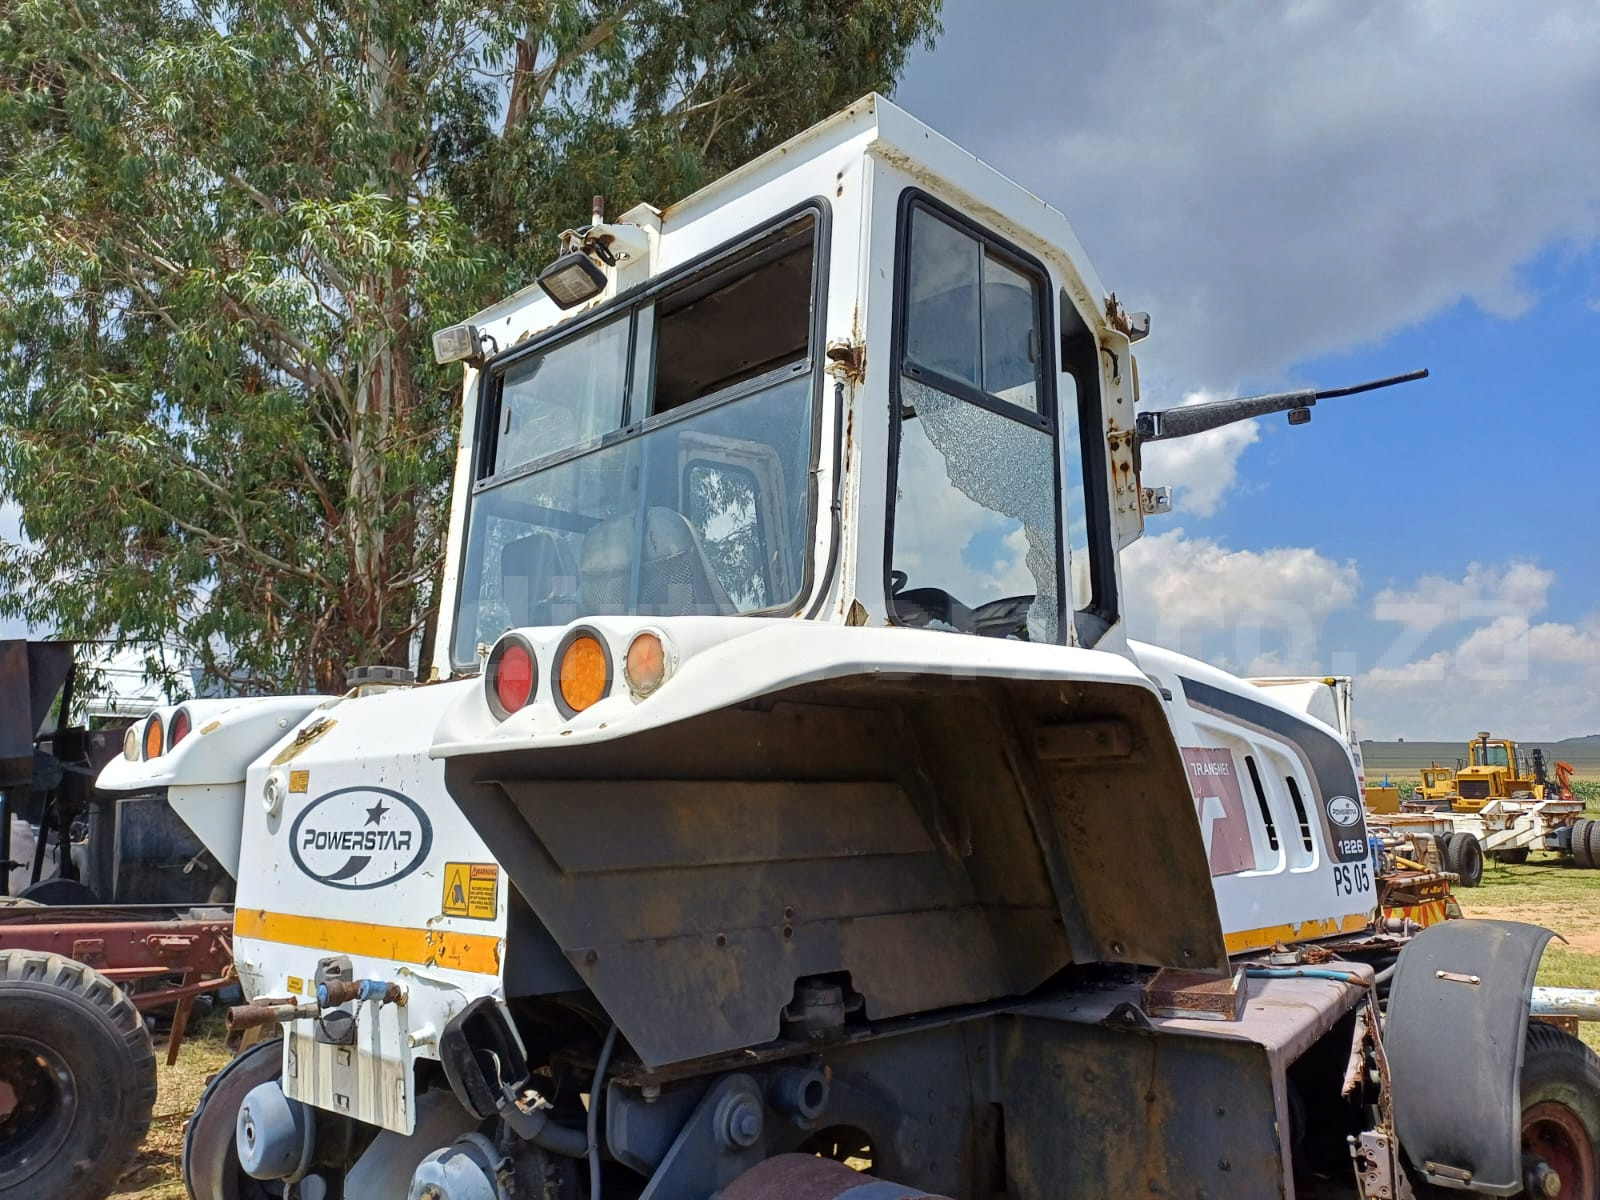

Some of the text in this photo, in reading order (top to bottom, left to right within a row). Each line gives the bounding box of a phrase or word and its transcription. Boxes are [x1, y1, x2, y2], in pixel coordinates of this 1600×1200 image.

[303, 829, 412, 851] POWERSTAR
[1338, 839, 1364, 855] 1226
[1333, 863, 1370, 897] PS 05
